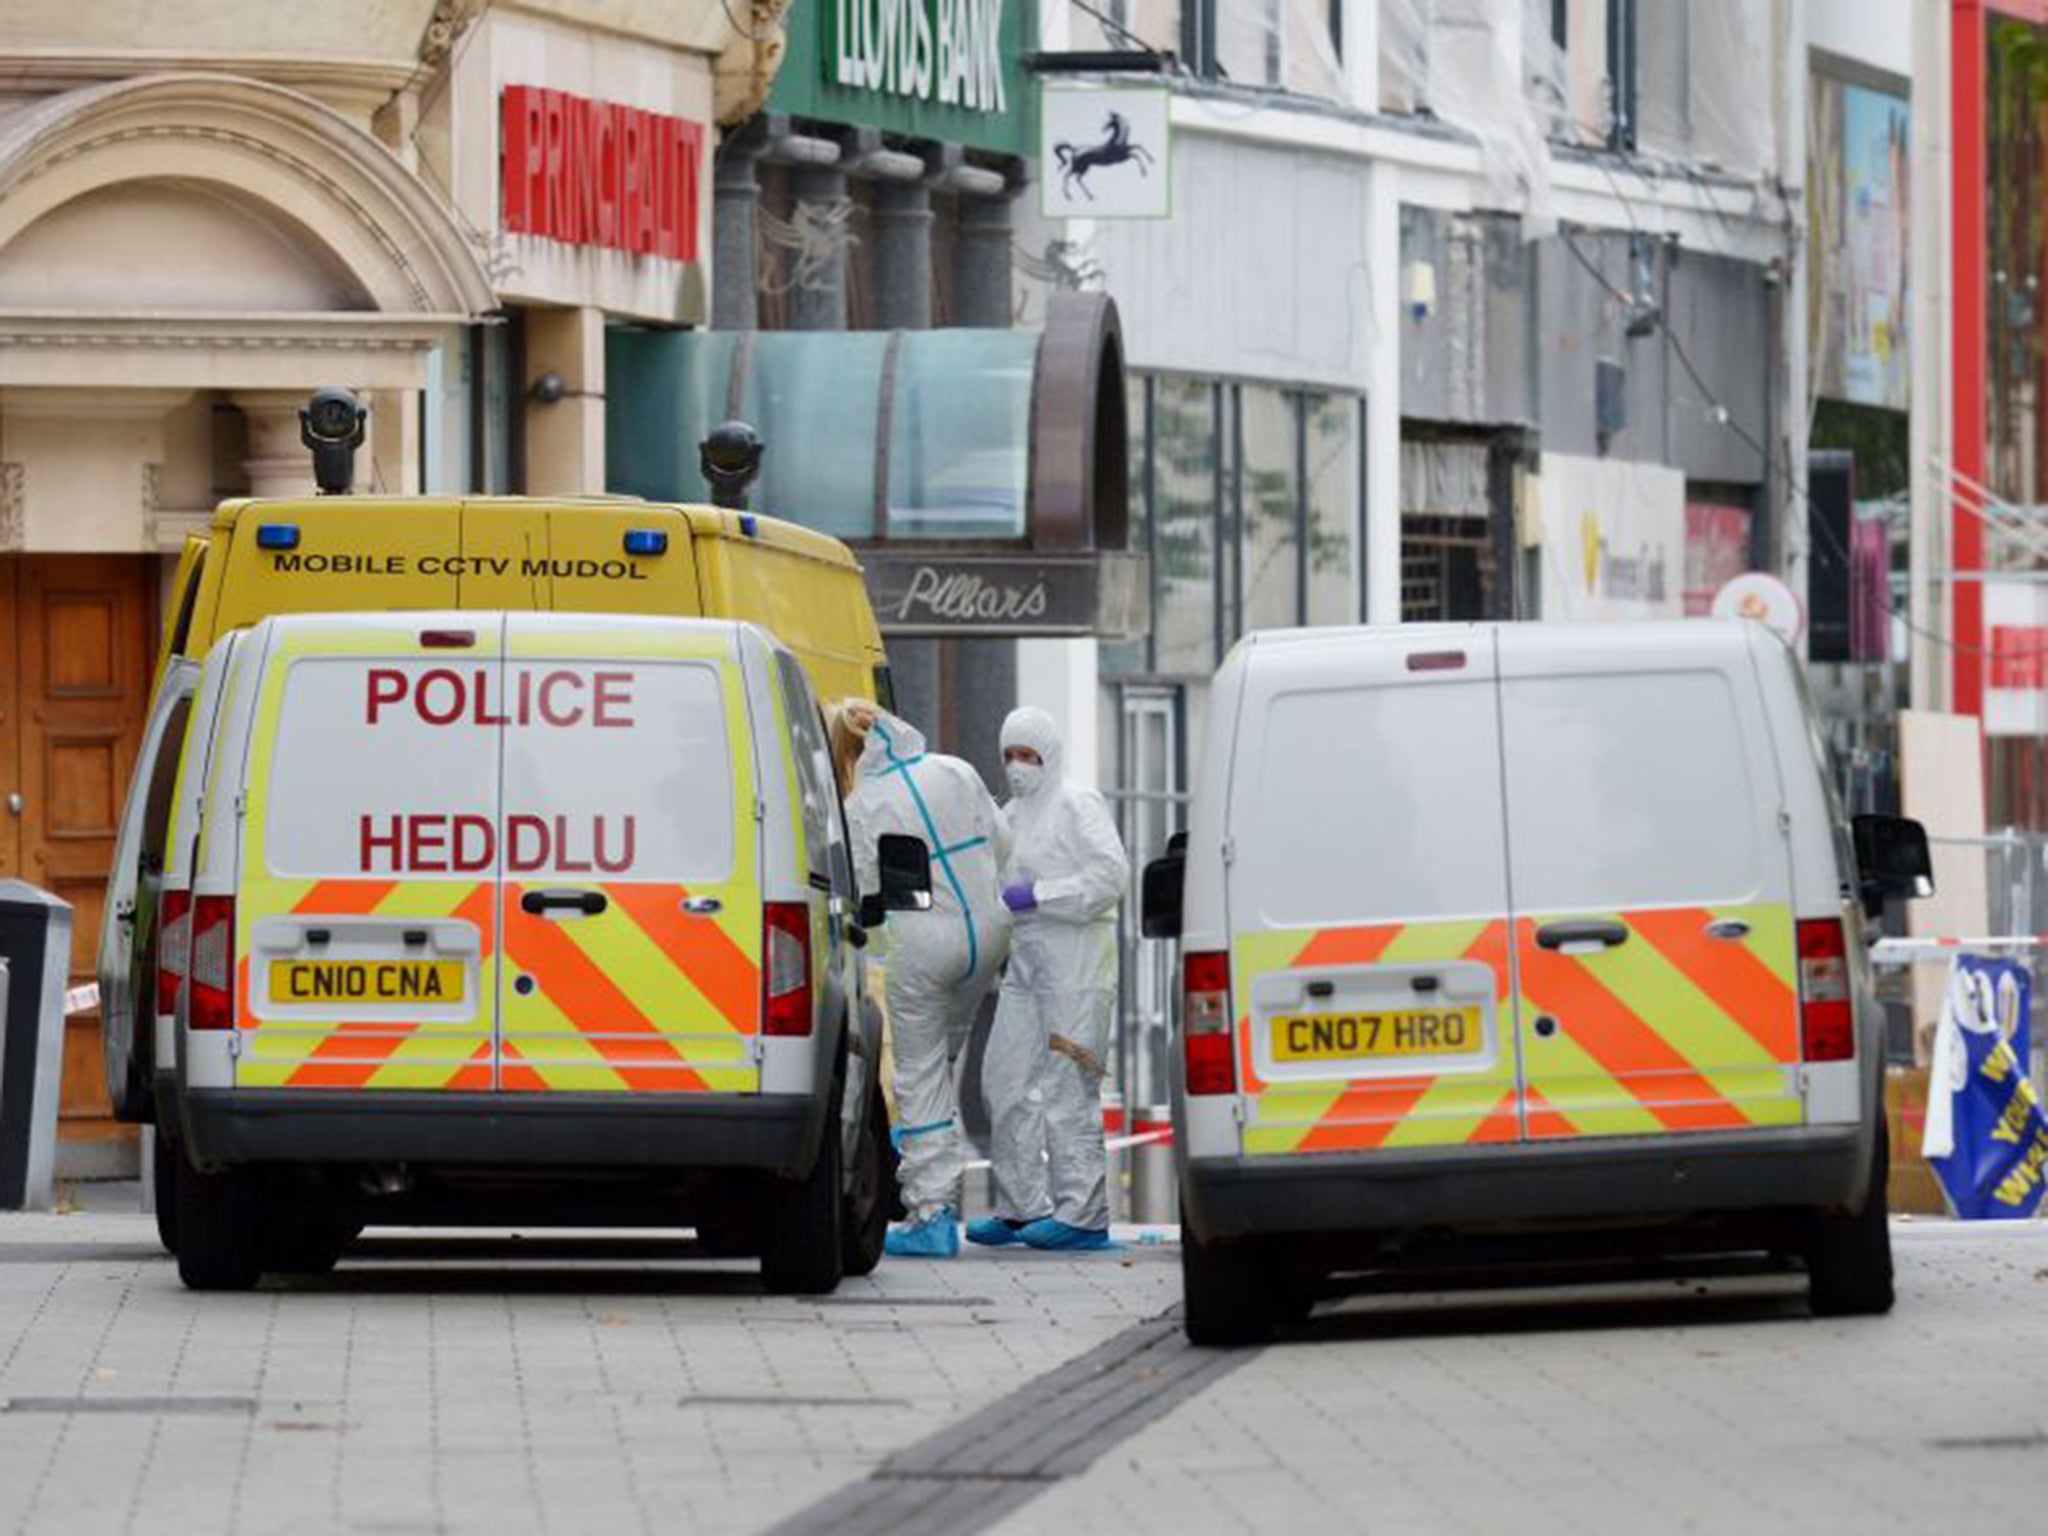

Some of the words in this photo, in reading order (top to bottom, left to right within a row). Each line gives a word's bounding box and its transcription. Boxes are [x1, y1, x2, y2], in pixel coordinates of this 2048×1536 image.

[837, 0, 932, 100] LLOYDS
[937, 0, 1006, 113] BANK
[503, 84, 704, 264] PRINCIPALITY
[273, 553, 406, 575] MOBILE
[417, 556, 510, 576] CCTV
[521, 558, 648, 580] MUDOL
[366, 668, 634, 728] POLICE
[360, 814, 635, 873] HEDDLU
[376, 965, 442, 997] CNA
[1287, 1016, 1382, 1053] CN07
